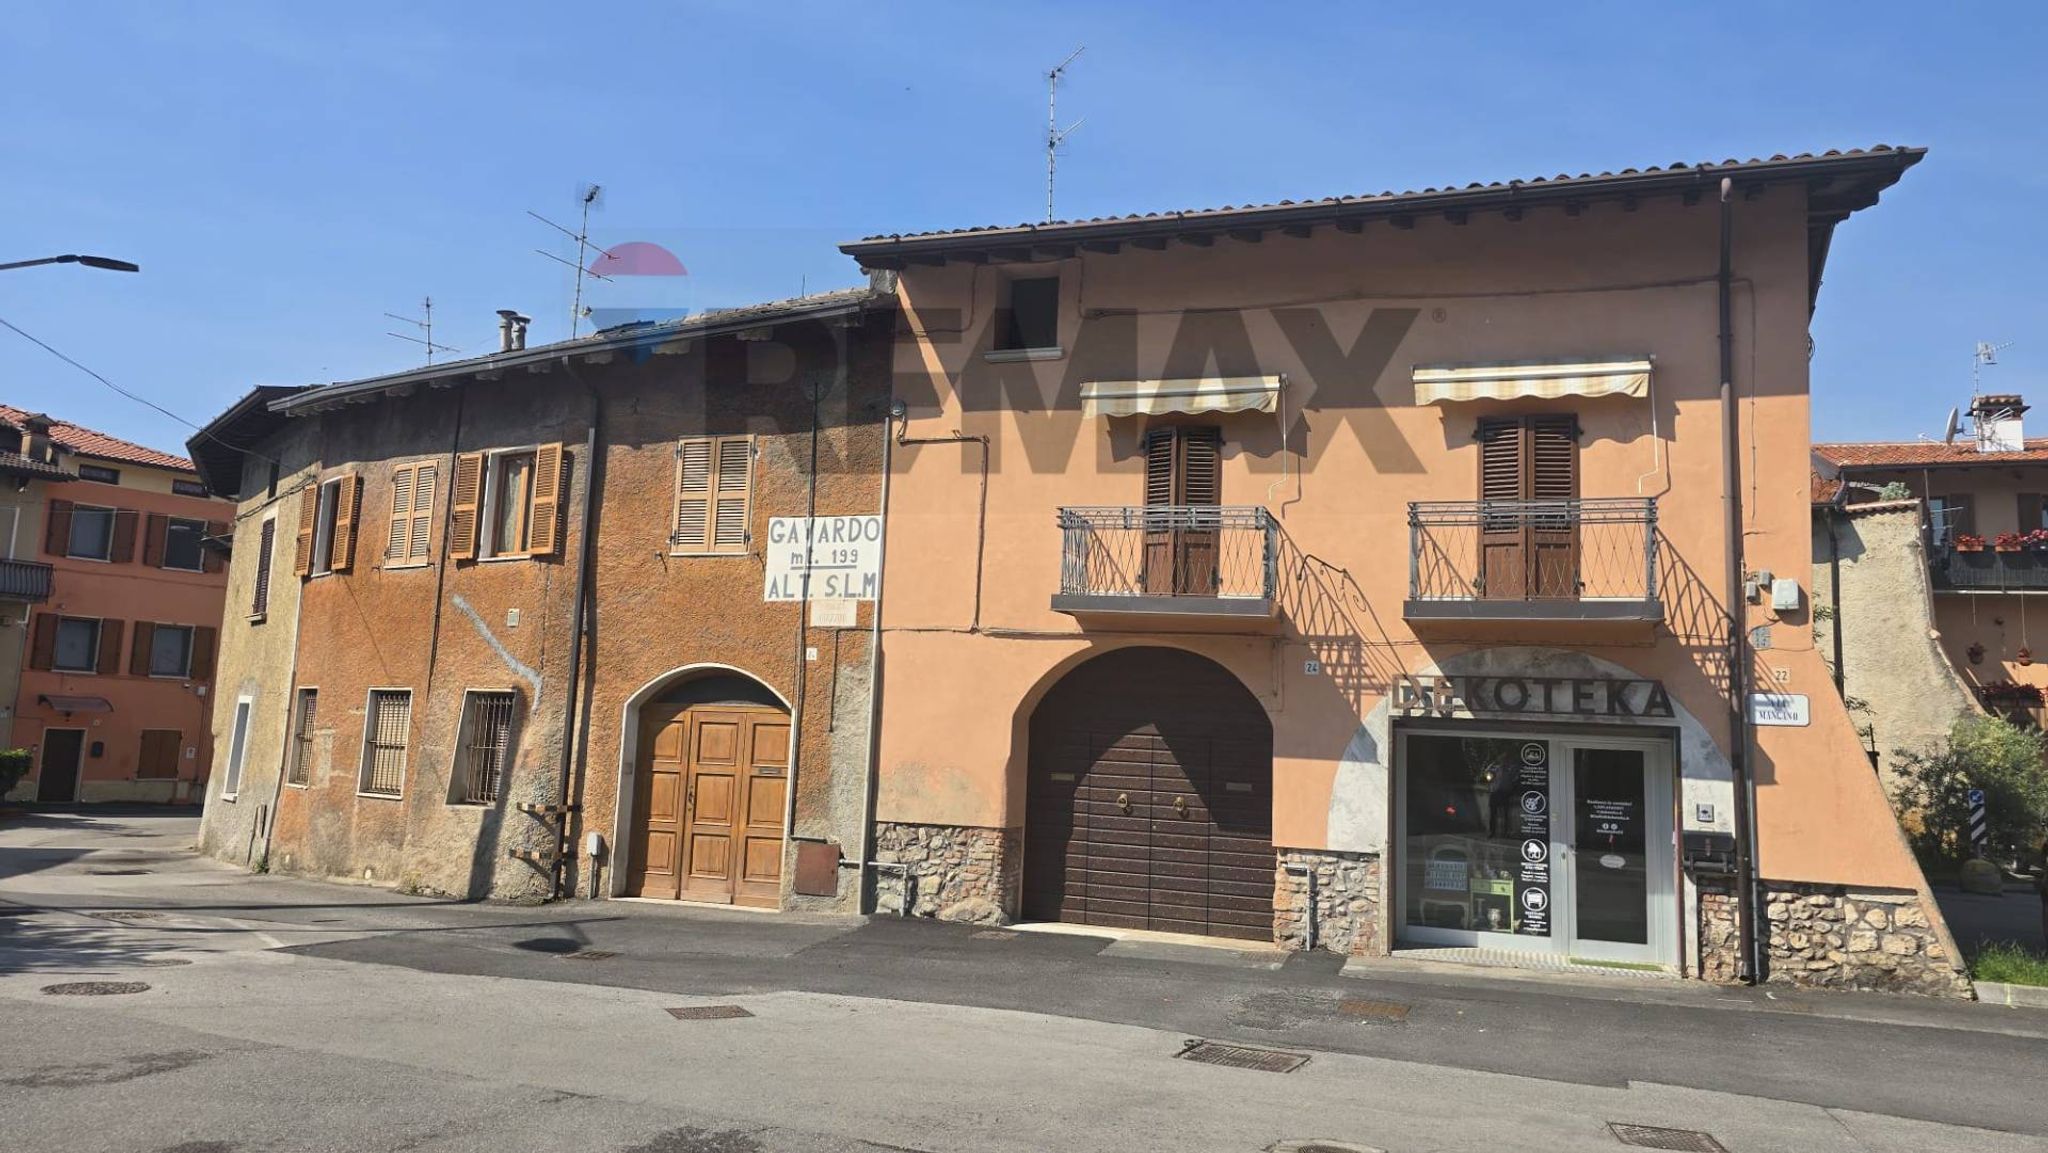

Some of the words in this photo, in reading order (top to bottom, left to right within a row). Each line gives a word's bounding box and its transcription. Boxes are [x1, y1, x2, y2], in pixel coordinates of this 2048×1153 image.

[832, 549, 859, 564] 199
[1776, 670, 1787, 681] 22
[1392, 674, 1676, 717] DEKOTEKA
